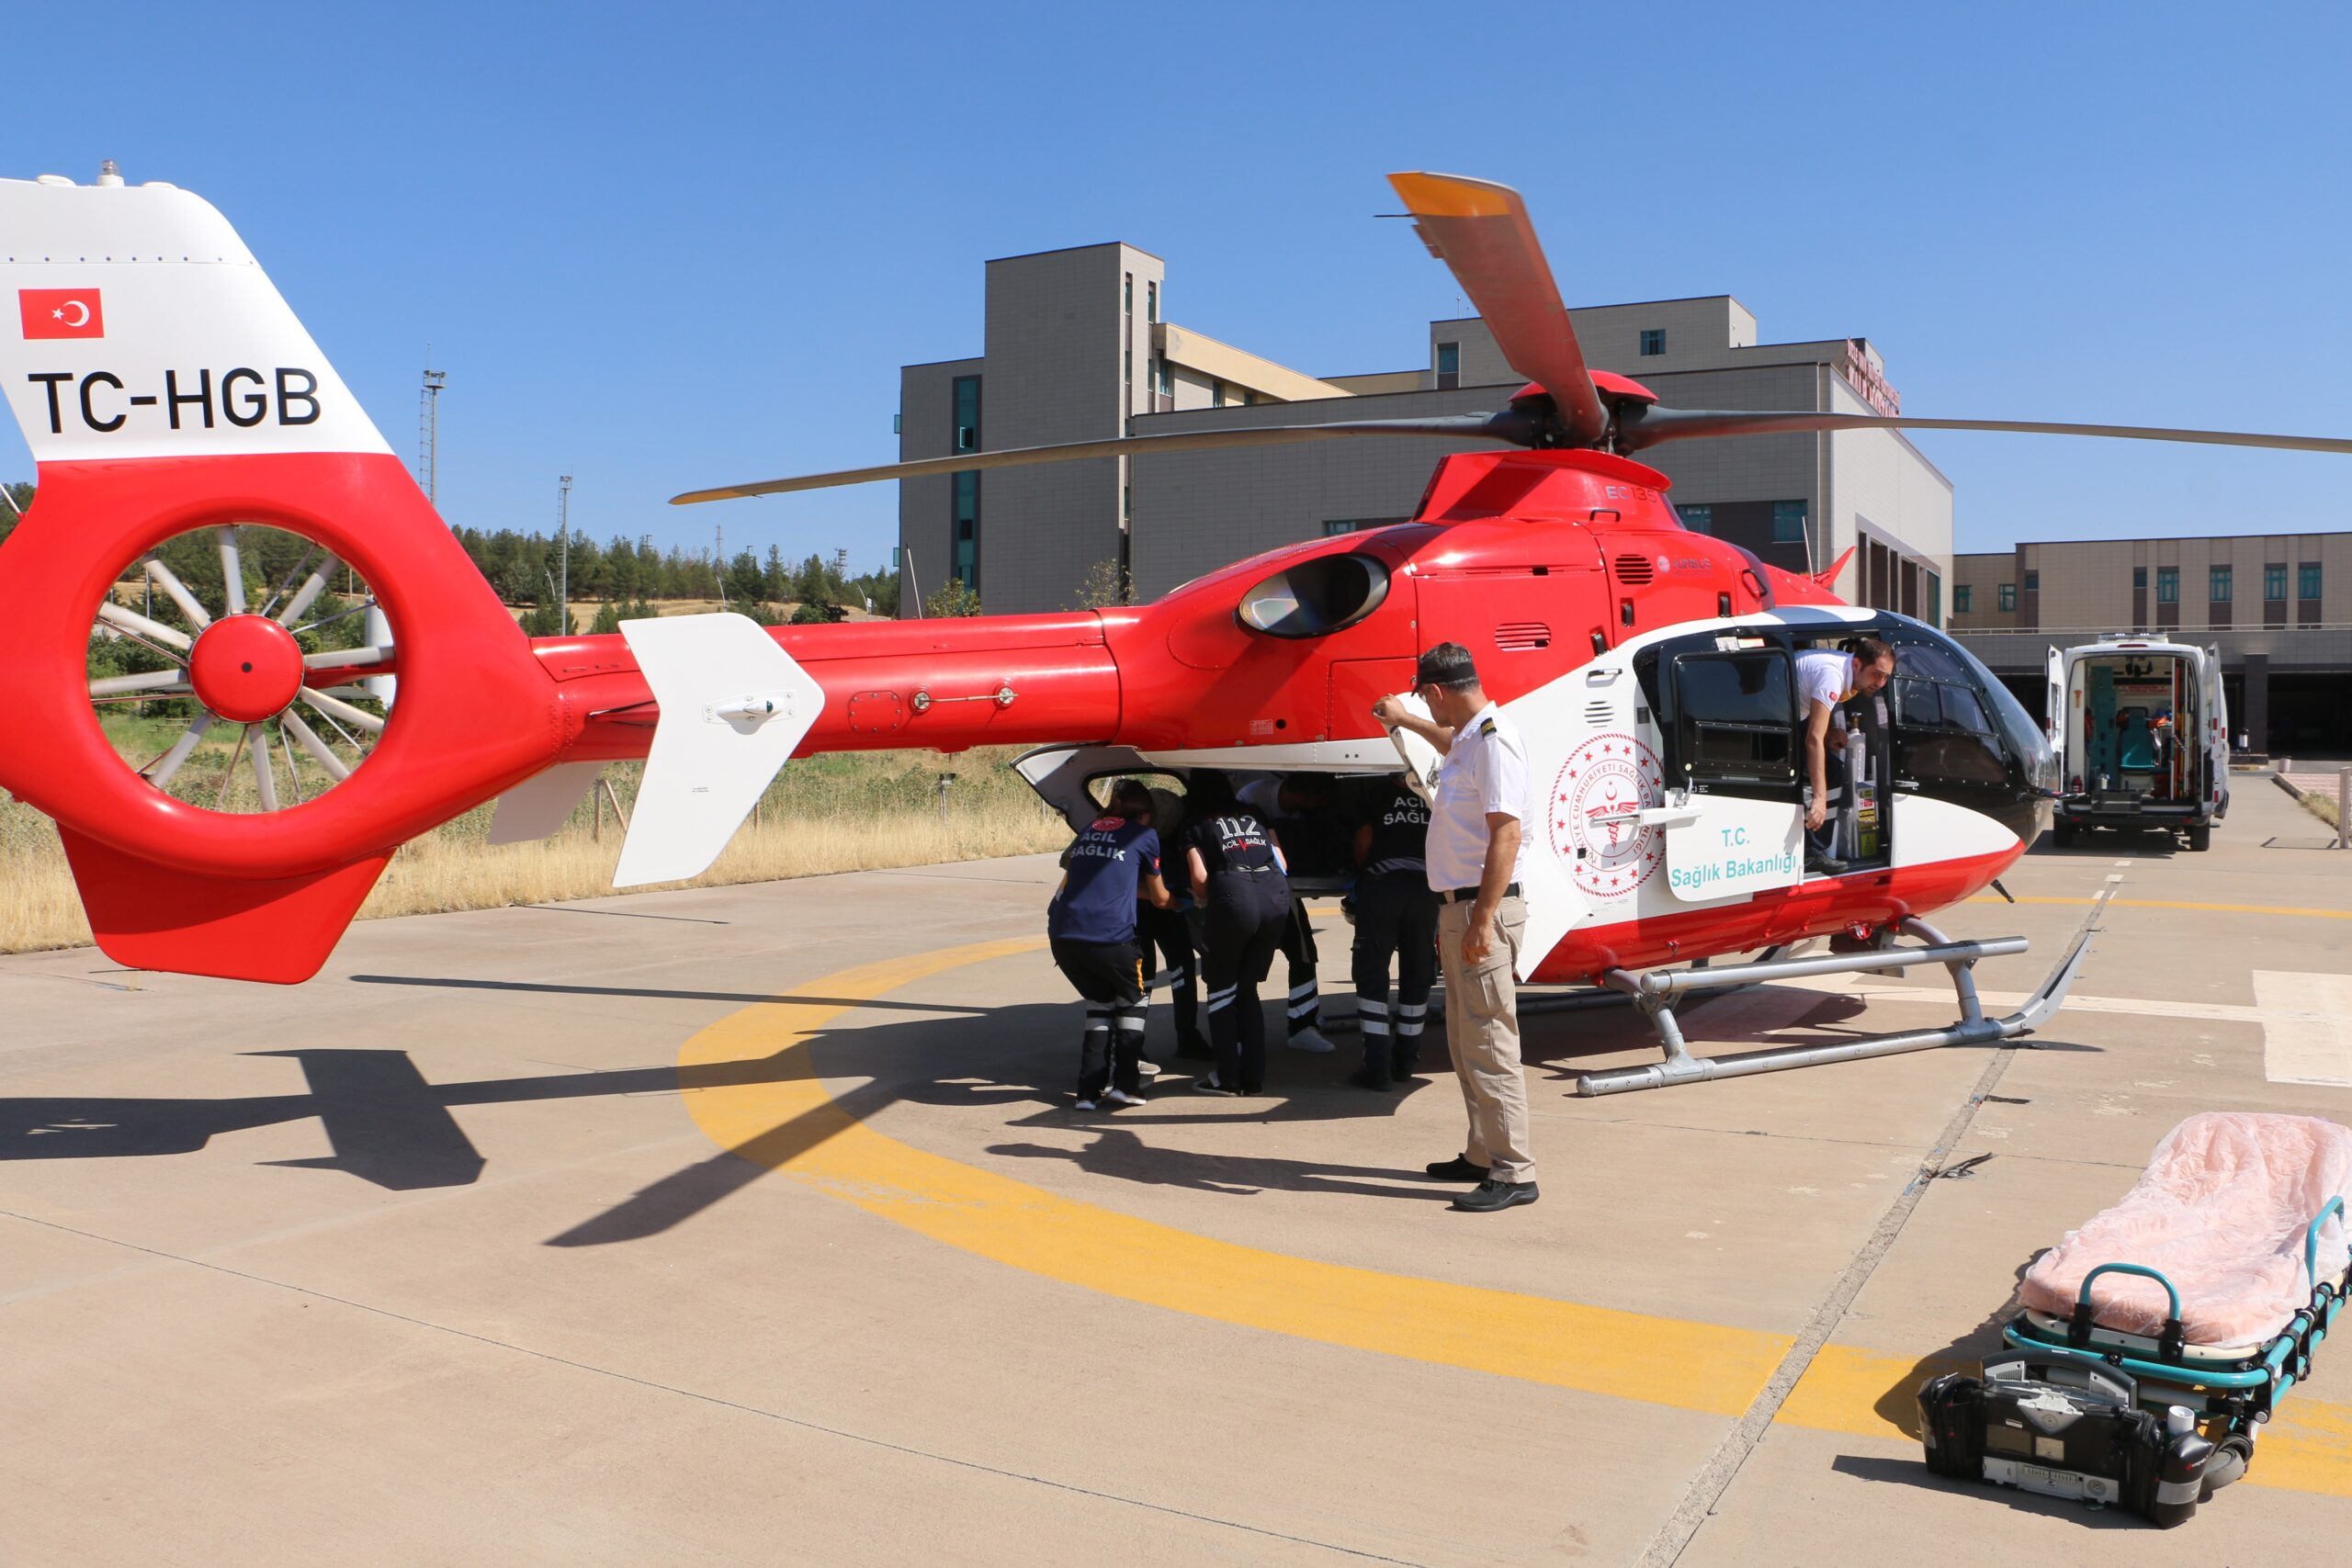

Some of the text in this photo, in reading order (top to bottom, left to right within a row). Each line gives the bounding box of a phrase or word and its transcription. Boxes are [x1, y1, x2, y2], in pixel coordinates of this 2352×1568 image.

[28, 367, 321, 434] TC-HGB
[1216, 815, 1261, 840] 112
[1383, 808, 1430, 825] SAĞL
[1573, 826, 1599, 864] TÜKİYE
[1633, 793, 1654, 854] BANLIĞI
[1721, 827, 1750, 847] T.C.
[1670, 852, 1797, 889] Sağlık Bakanlığı
